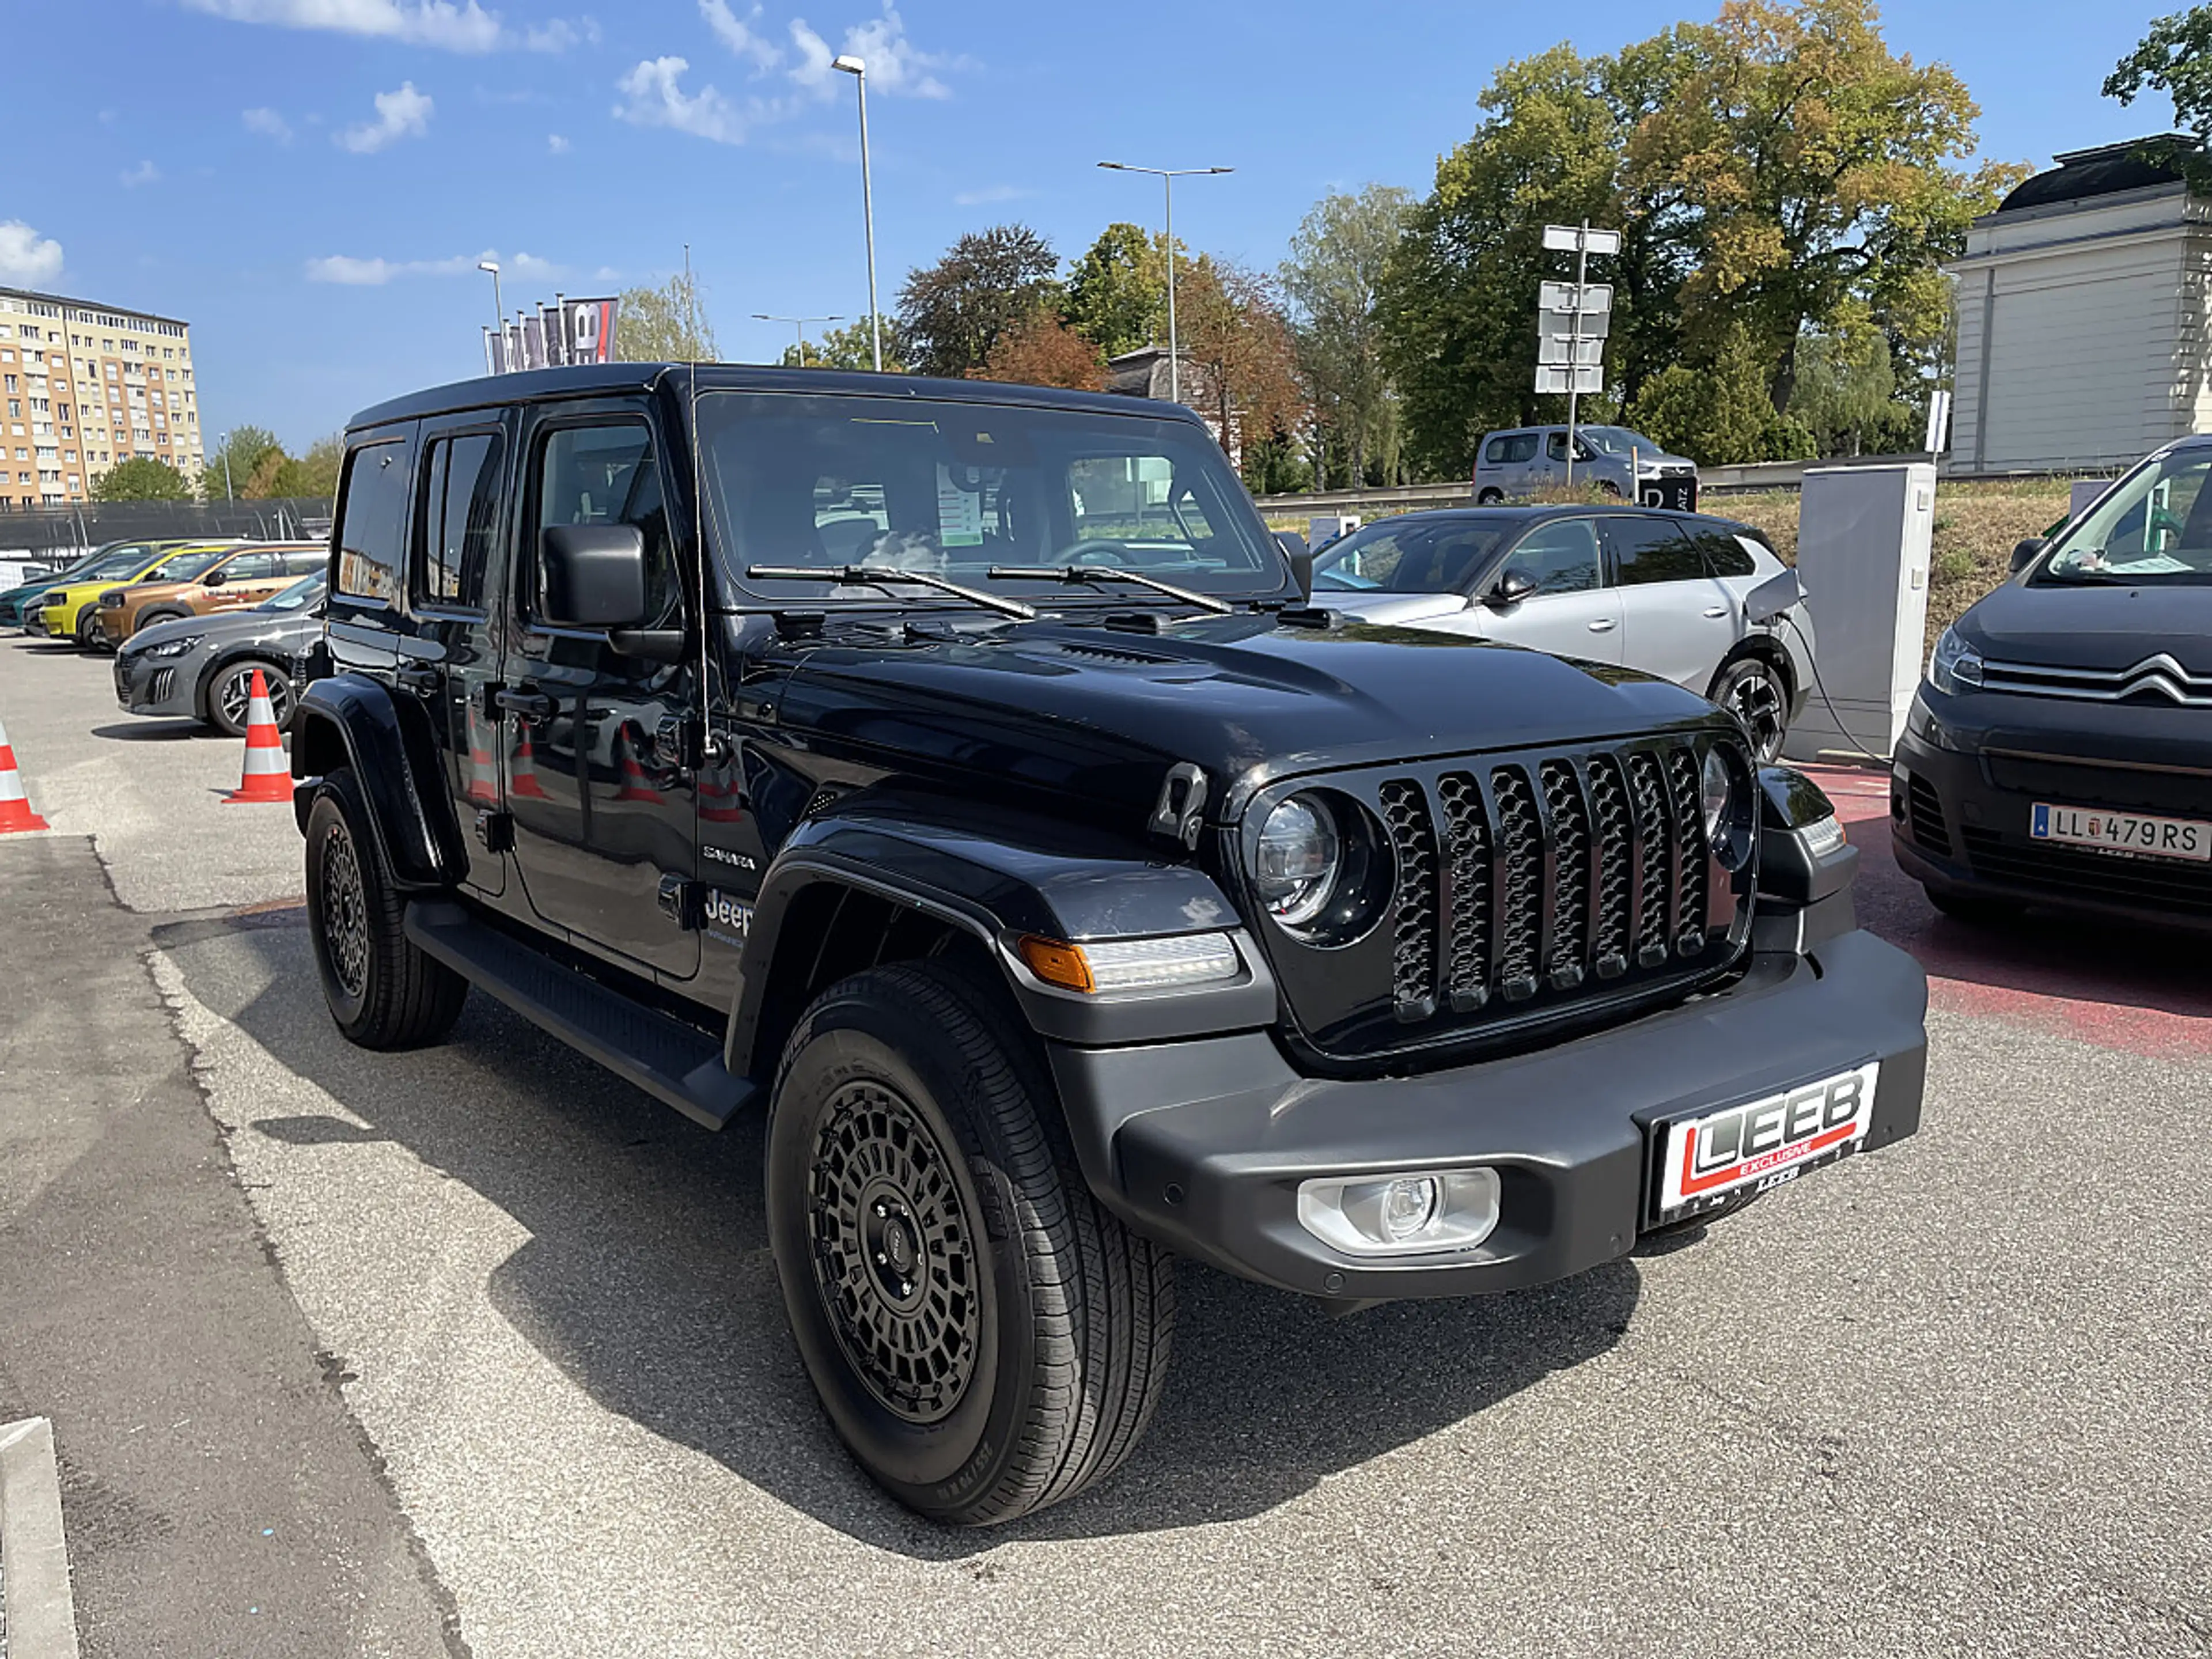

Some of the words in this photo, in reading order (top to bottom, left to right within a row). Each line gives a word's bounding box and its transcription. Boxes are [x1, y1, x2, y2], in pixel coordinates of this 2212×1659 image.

[2056, 811, 2082, 836] LL
[703, 846, 756, 871] SAHARA
[1695, 1073, 1865, 1173] LEEB
[1740, 1141, 1812, 1176] EXCLUSIVE
